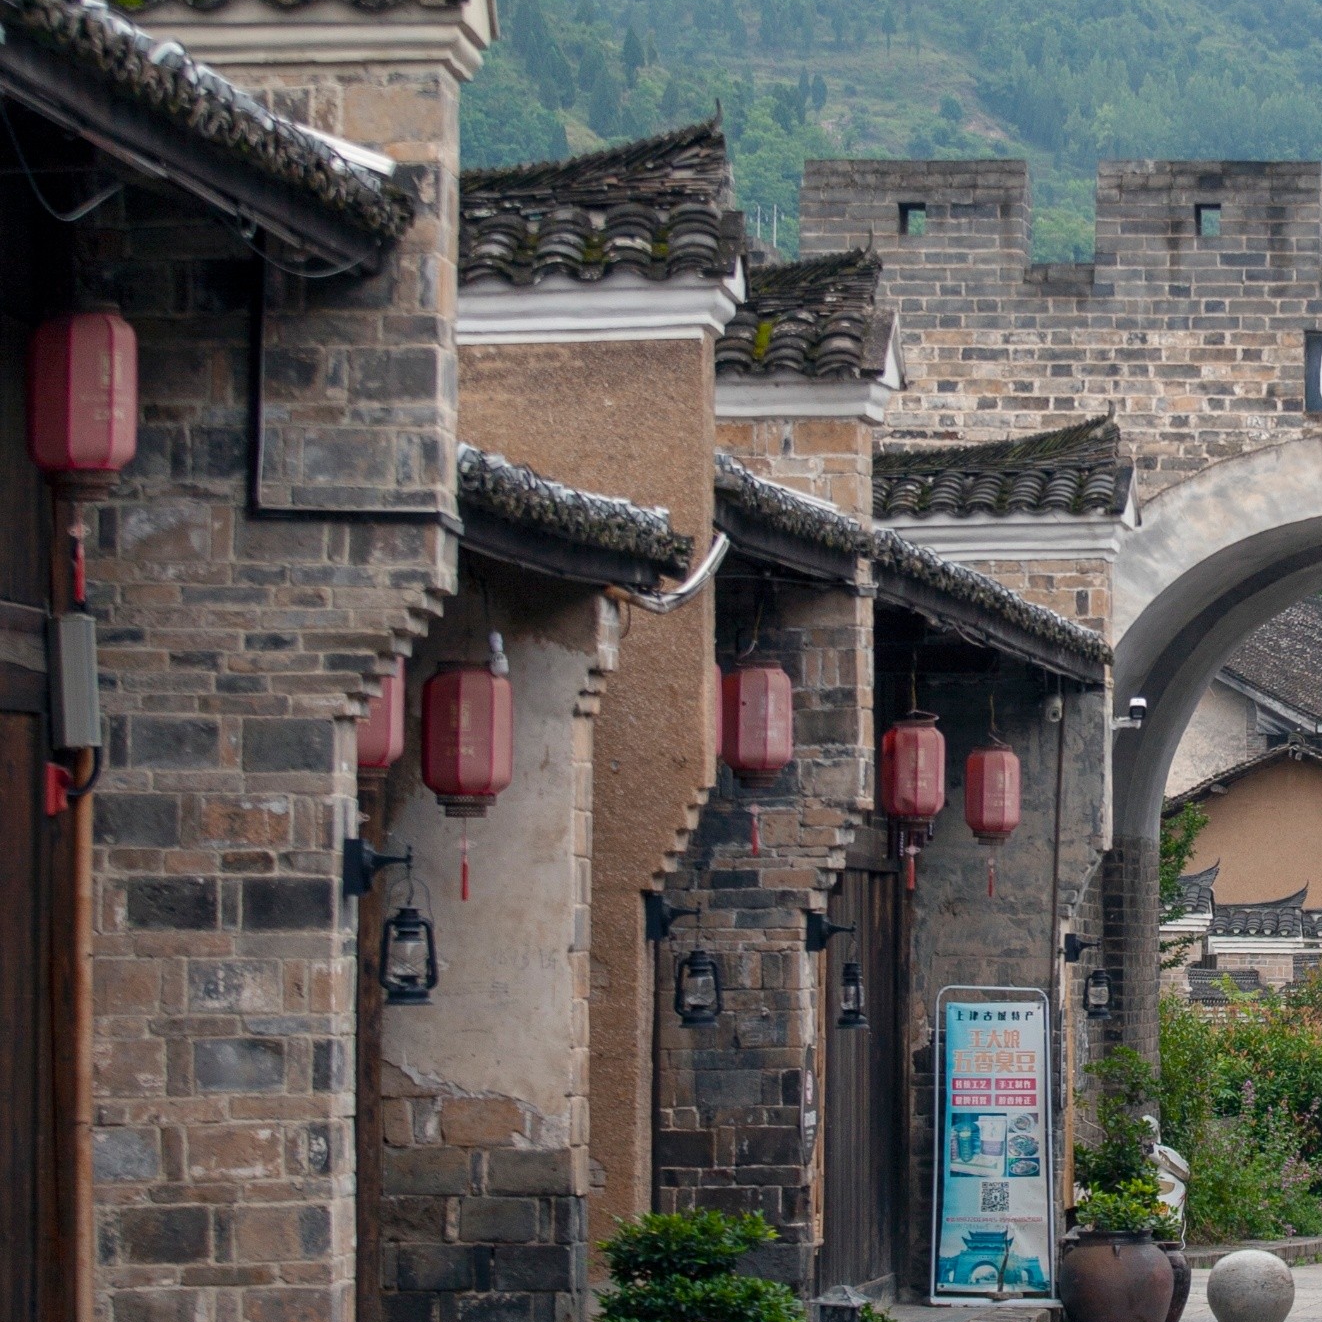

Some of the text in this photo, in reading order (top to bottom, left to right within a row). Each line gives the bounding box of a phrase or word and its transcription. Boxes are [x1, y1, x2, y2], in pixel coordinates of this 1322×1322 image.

[957, 1011, 1033, 1021] 上津古城特产
[970, 1030, 1020, 1048] 王大娘
[954, 1050, 1036, 1073] 五香臭豆
